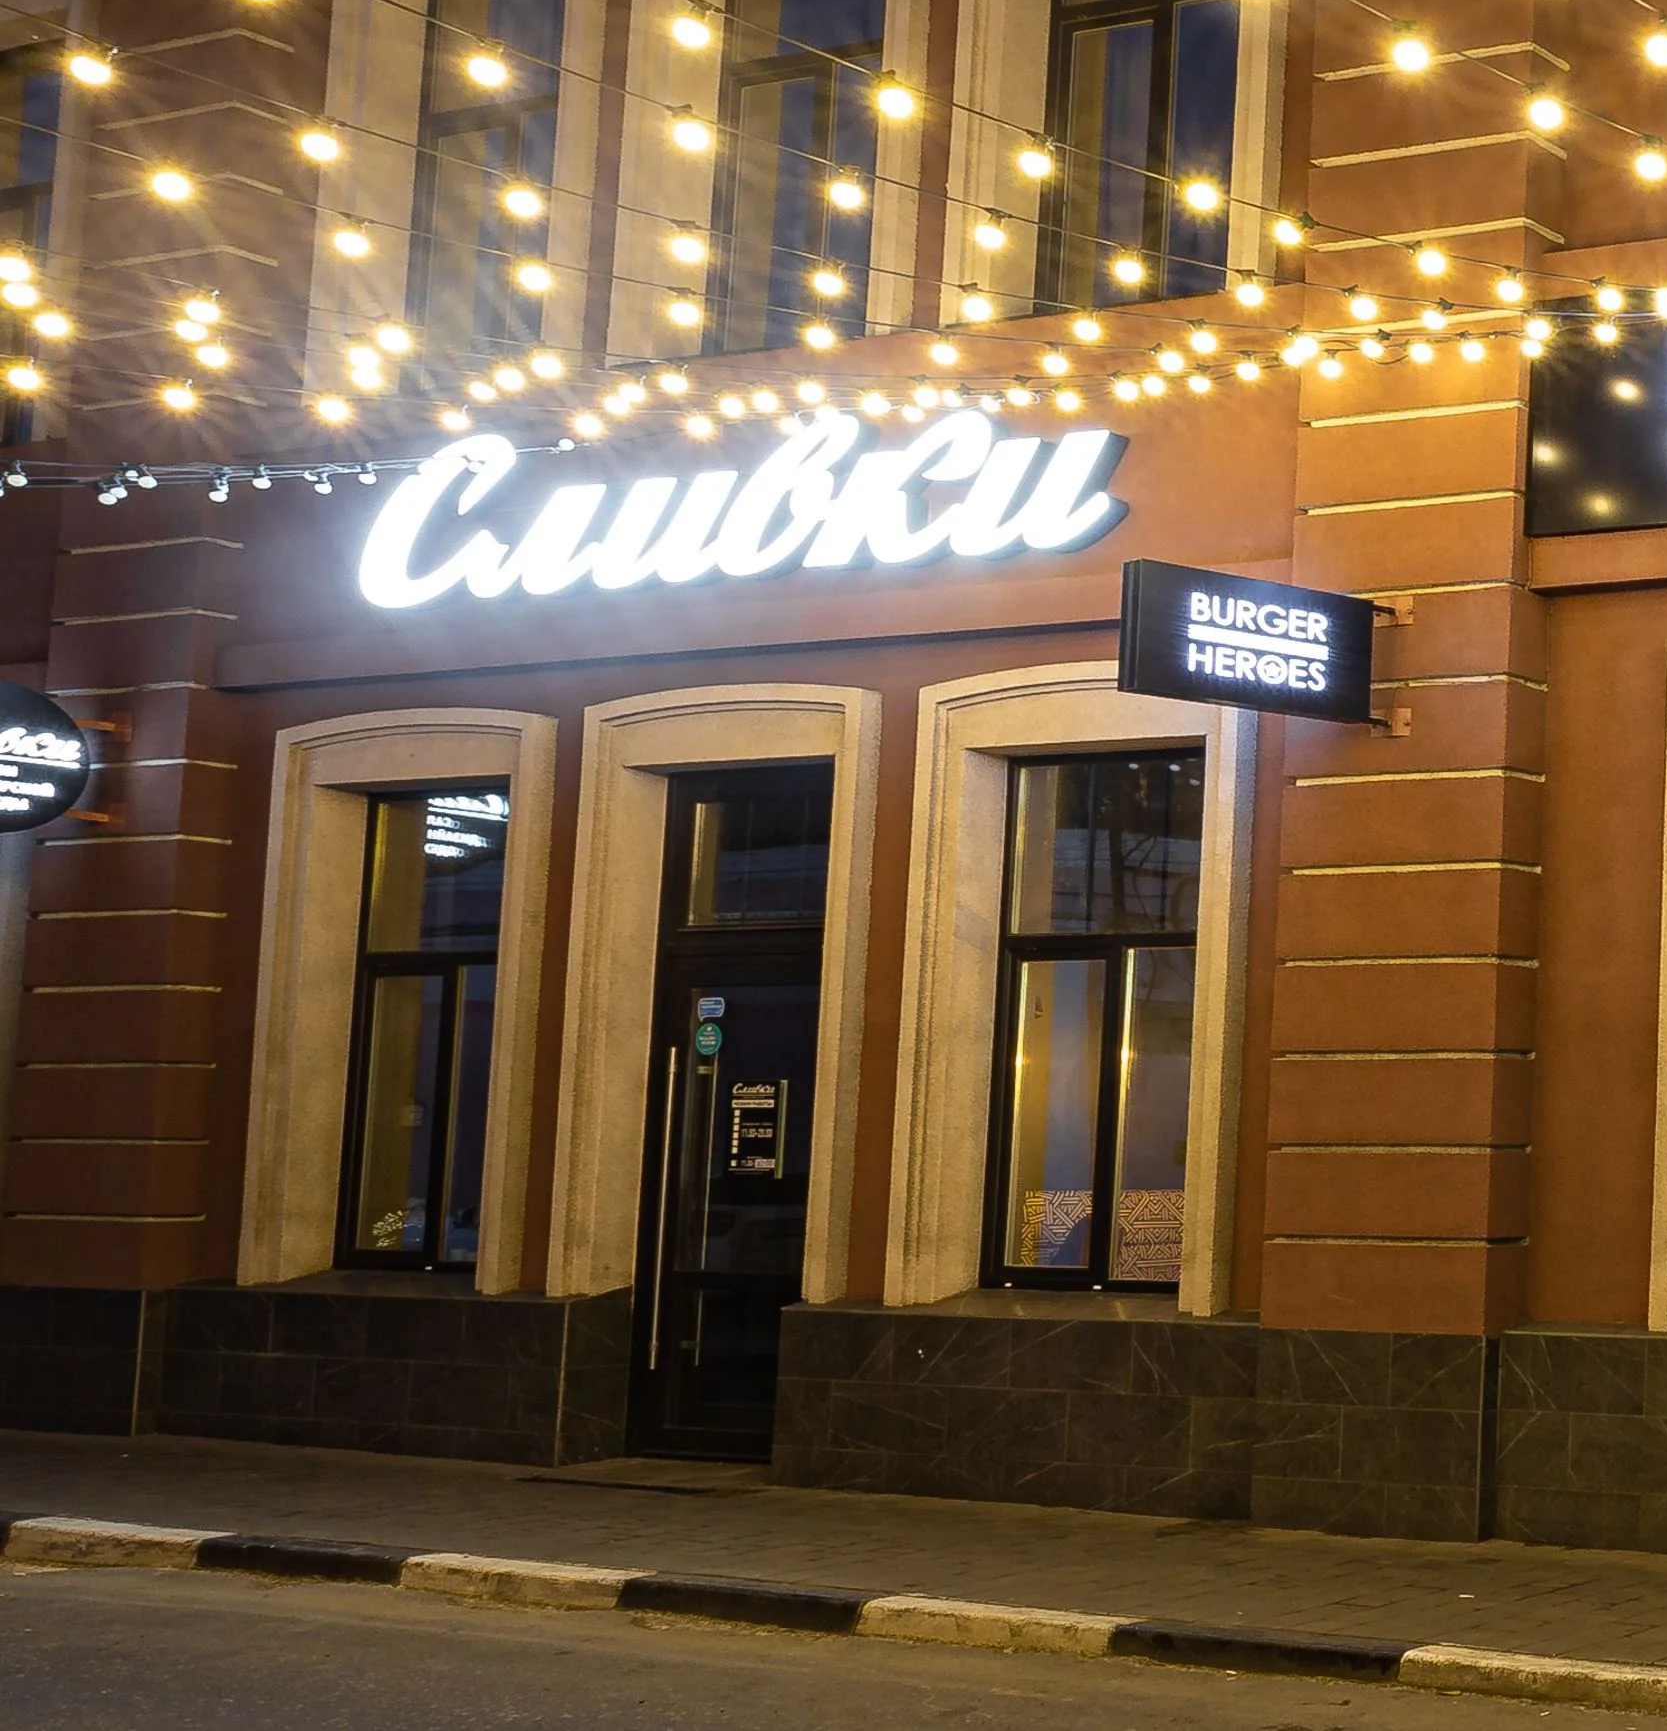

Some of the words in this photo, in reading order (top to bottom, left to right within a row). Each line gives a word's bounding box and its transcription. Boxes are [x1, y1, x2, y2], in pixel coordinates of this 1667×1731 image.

[358, 411, 1114, 610] Сливки
[1190, 591, 1329, 642] BURGER
[1187, 643, 1327, 691] HEROES
